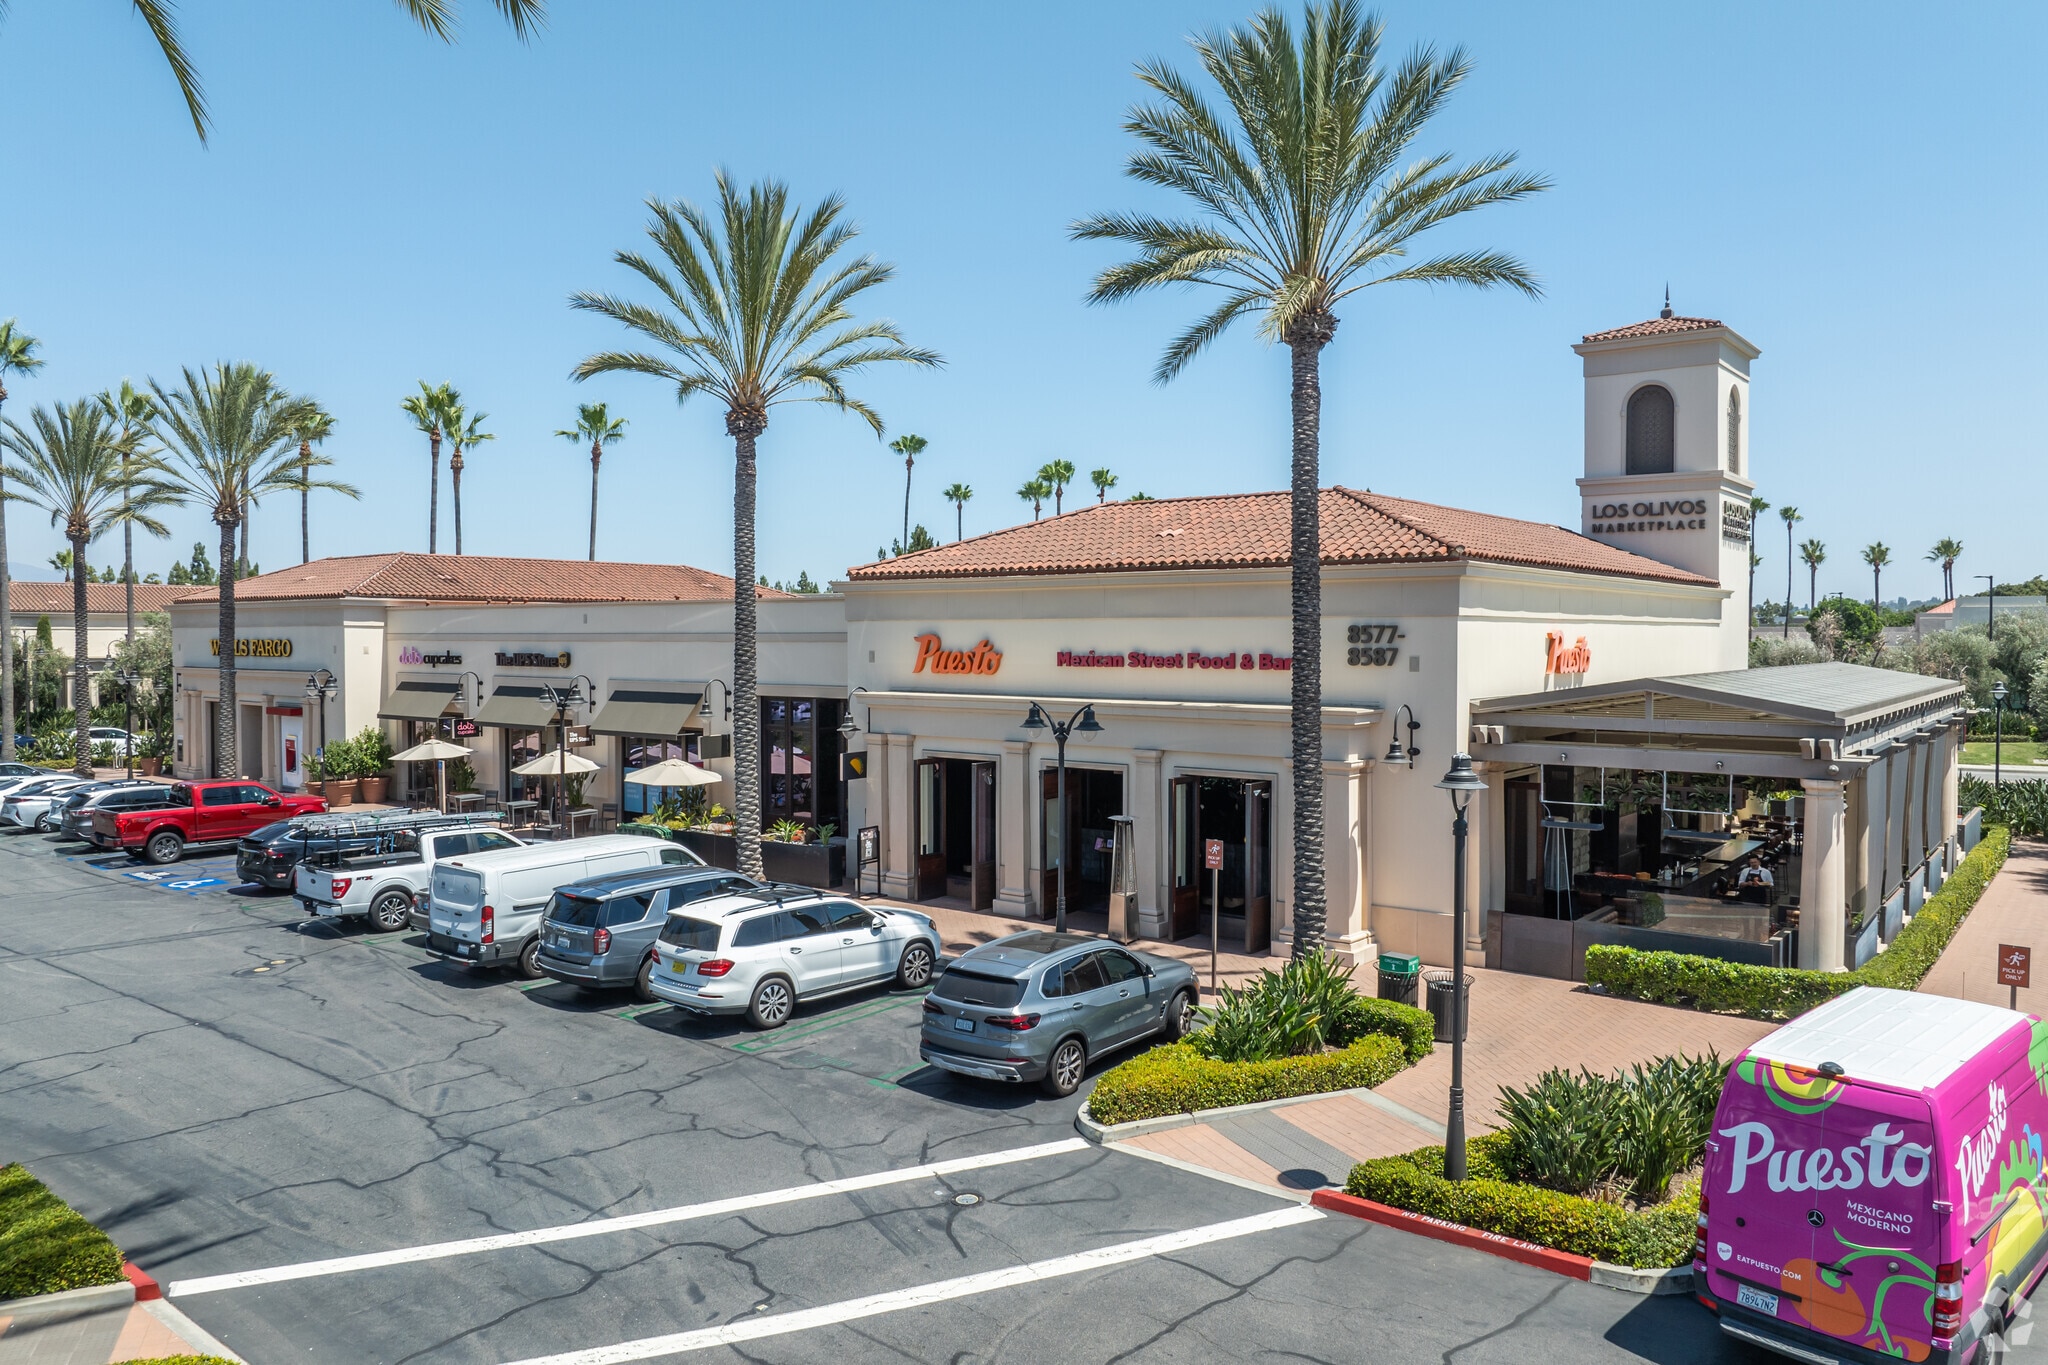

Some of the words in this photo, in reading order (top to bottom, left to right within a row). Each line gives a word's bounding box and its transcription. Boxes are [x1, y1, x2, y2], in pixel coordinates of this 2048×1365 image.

[1592, 503, 1629, 519] LOS
[1633, 500, 1706, 517] OLIVOS
[1592, 519, 1706, 533] MARKETPLACE
[1347, 625, 1405, 643] 8577-
[209, 639, 249, 656] WLS
[250, 639, 292, 657] FARGO
[912, 634, 1003, 675] Puesto
[1347, 647, 1398, 666] 8587
[1545, 630, 1592, 675] Puesto
[494, 652, 513, 666] The
[513, 653, 533, 666] UPS
[533, 653, 560, 667] Store
[1056, 650, 1124, 667] Mexican
[1127, 651, 1183, 668] Street
[1187, 653, 1236, 669] Food
[1240, 653, 1254, 670] &
[1258, 653, 1292, 670] Bar
[457, 721, 475, 731] dots
[1718, 1121, 1933, 1194] Puesto
[1954, 1079, 2007, 1227] Puesto
[1846, 1200, 1913, 1224] MEXICANO
[1847, 1211, 1911, 1234] MODERNO
[1401, 1211, 1418, 1219] NO
[1420, 1215, 1468, 1232] PARKING
[1481, 1231, 1510, 1244] FIRE
[1512, 1240, 1544, 1252] LANE
[1736, 1254, 1802, 1281] EATPUESTO.COM
[1741, 1291, 1775, 1312] 78947N2
